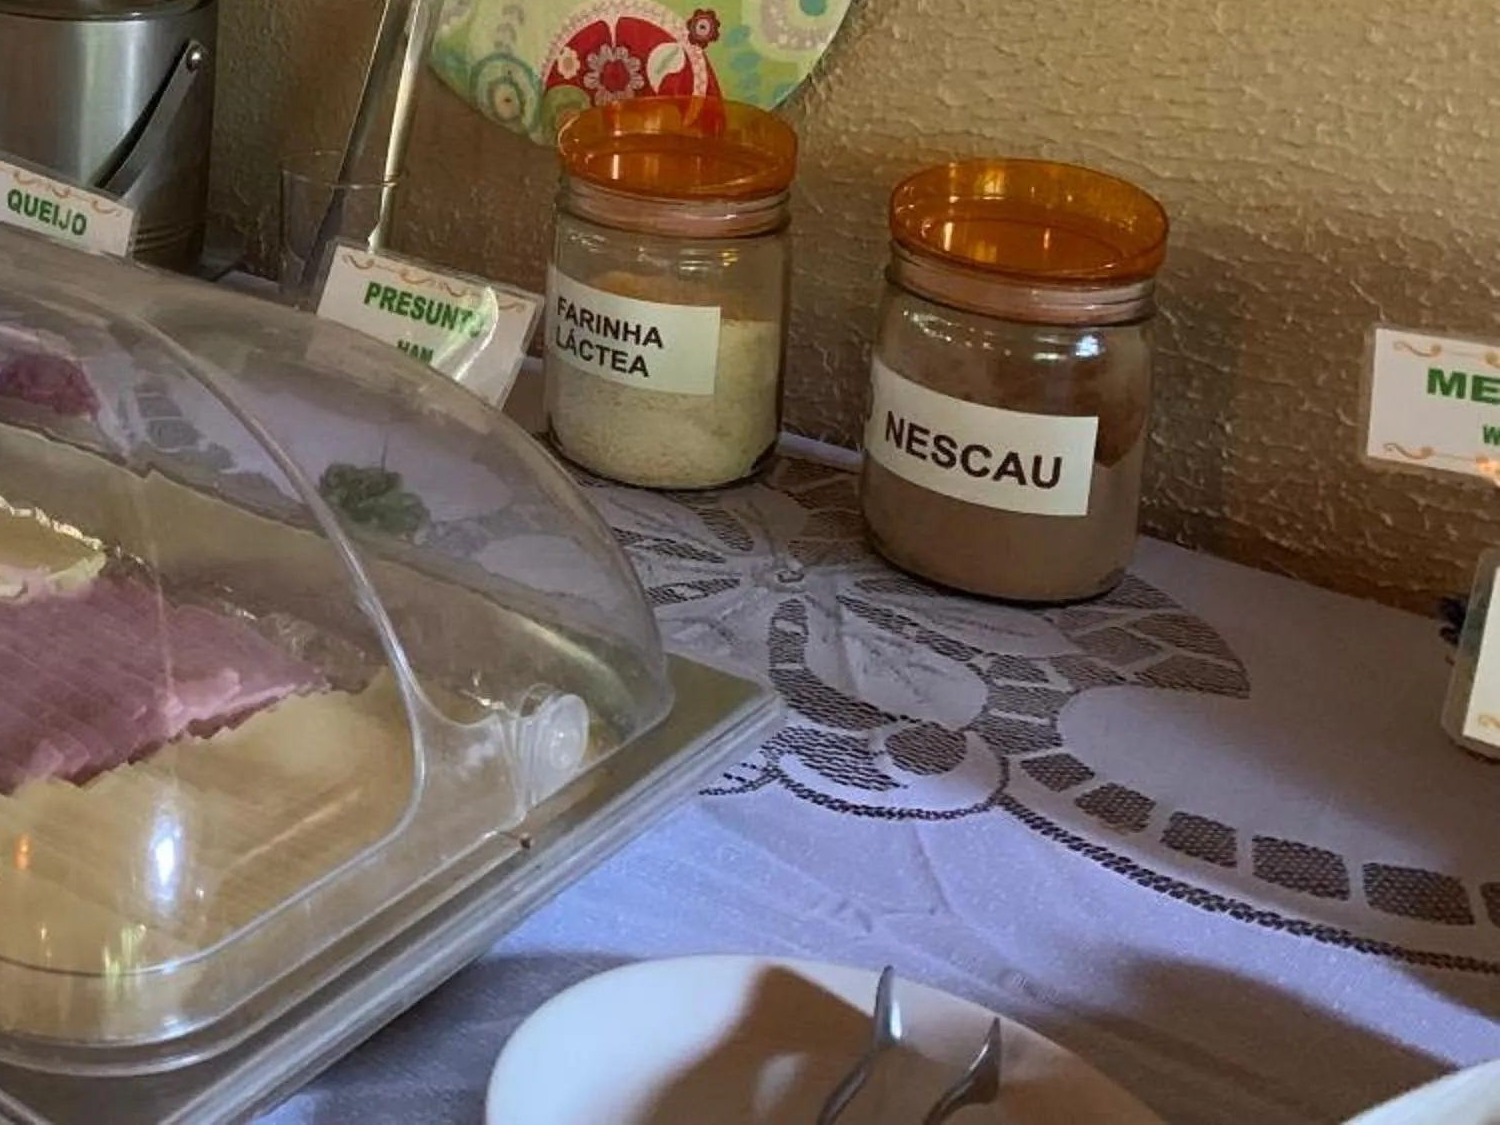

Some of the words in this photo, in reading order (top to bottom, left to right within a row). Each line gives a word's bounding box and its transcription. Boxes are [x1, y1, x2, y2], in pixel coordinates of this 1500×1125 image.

[7, 188, 87, 236] QUEIJO
[557, 295, 663, 349] FARINHA
[555, 325, 650, 377] LÁCTEA
[885, 410, 1063, 489] NESCAU
